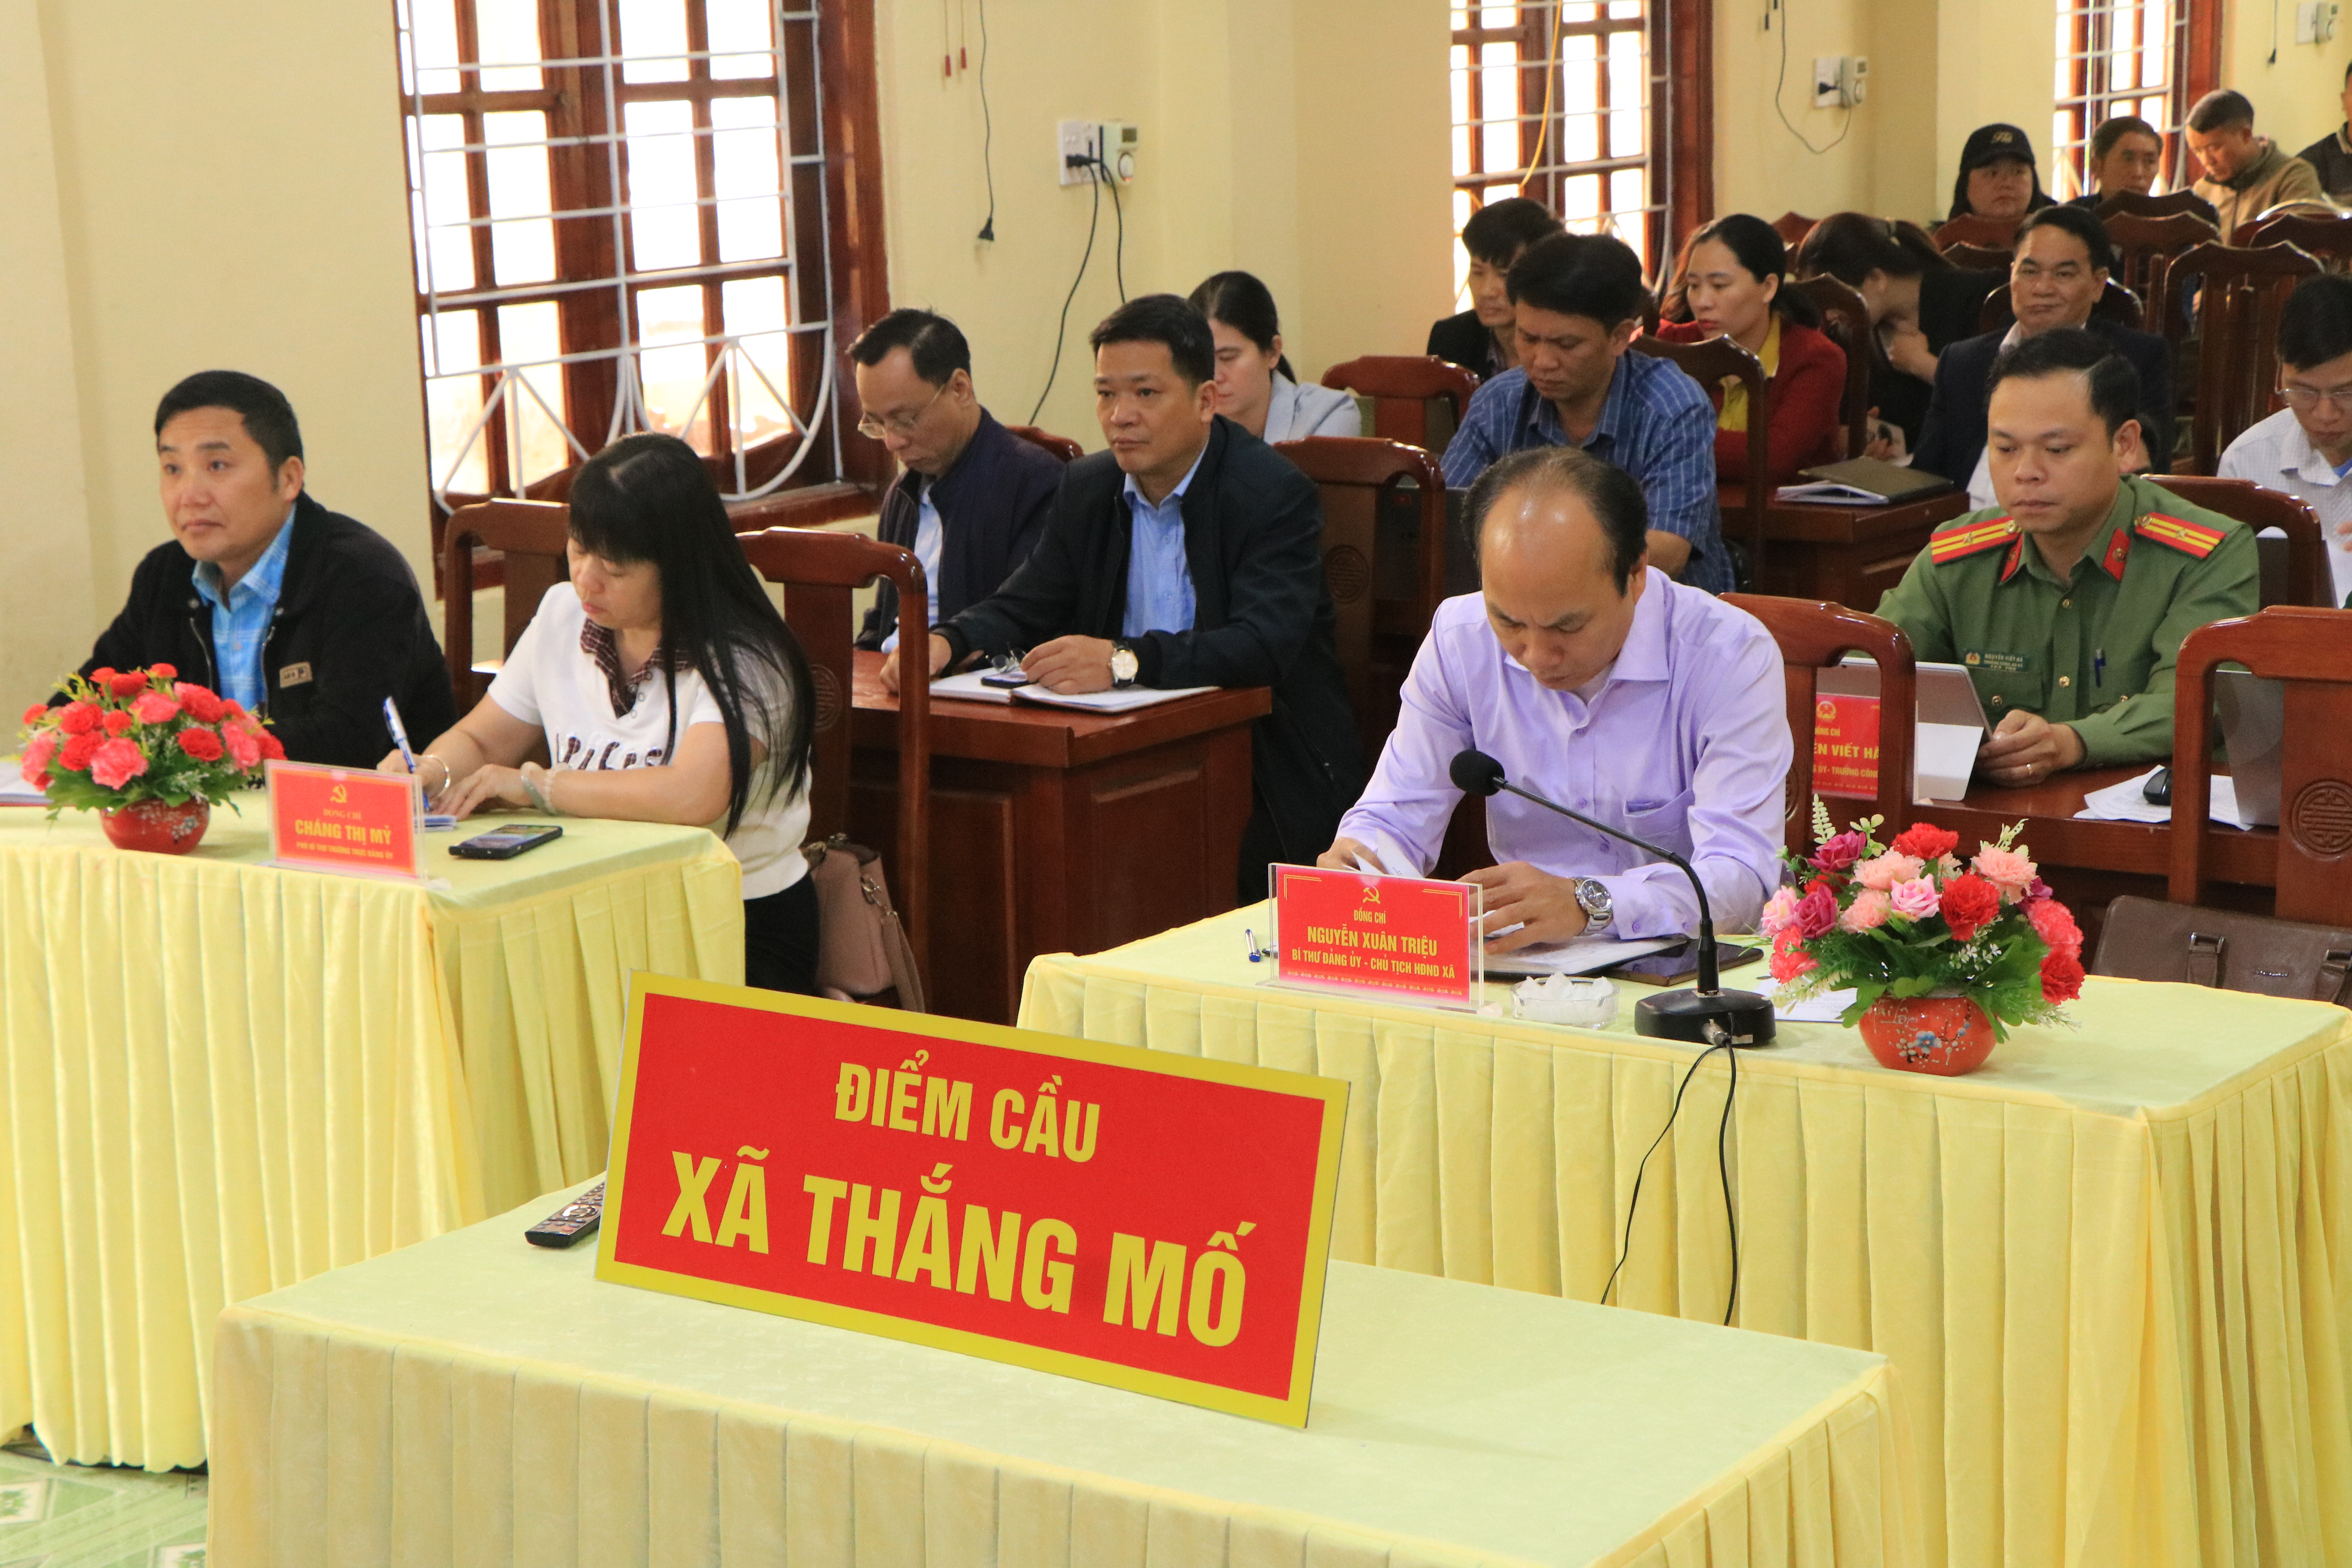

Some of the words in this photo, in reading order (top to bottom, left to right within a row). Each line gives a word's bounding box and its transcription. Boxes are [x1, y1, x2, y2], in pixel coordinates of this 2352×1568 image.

[1831, 742, 1860, 758] VIẾT
[295, 818, 342, 839] CHÁNG
[345, 824, 367, 845] THỊ
[1354, 907, 1373, 923] ĐỒNG
[1374, 911, 1386, 924] CHÍ
[1307, 924, 1358, 947] NGUYỄN
[1362, 930, 1397, 952] XUÂN
[1401, 935, 1437, 959] TRIỆU
[1292, 947, 1301, 961] BÍ
[1303, 949, 1321, 964] THƯ
[1322, 948, 1347, 966] ĐẢNG
[1350, 951, 1362, 968] ỦY
[1370, 954, 1389, 971] CHỦ
[1391, 960, 1412, 975] TỊCH
[1414, 962, 1439, 977] HĐND
[1442, 964, 1455, 979] XÃ
[835, 1049, 973, 1141] ĐIỂM
[989, 1074, 1100, 1163] CẦU
[661, 1145, 769, 1254] XÃ
[803, 1162, 1077, 1314] THẮNG
[1103, 1221, 1257, 1347] MỐ
